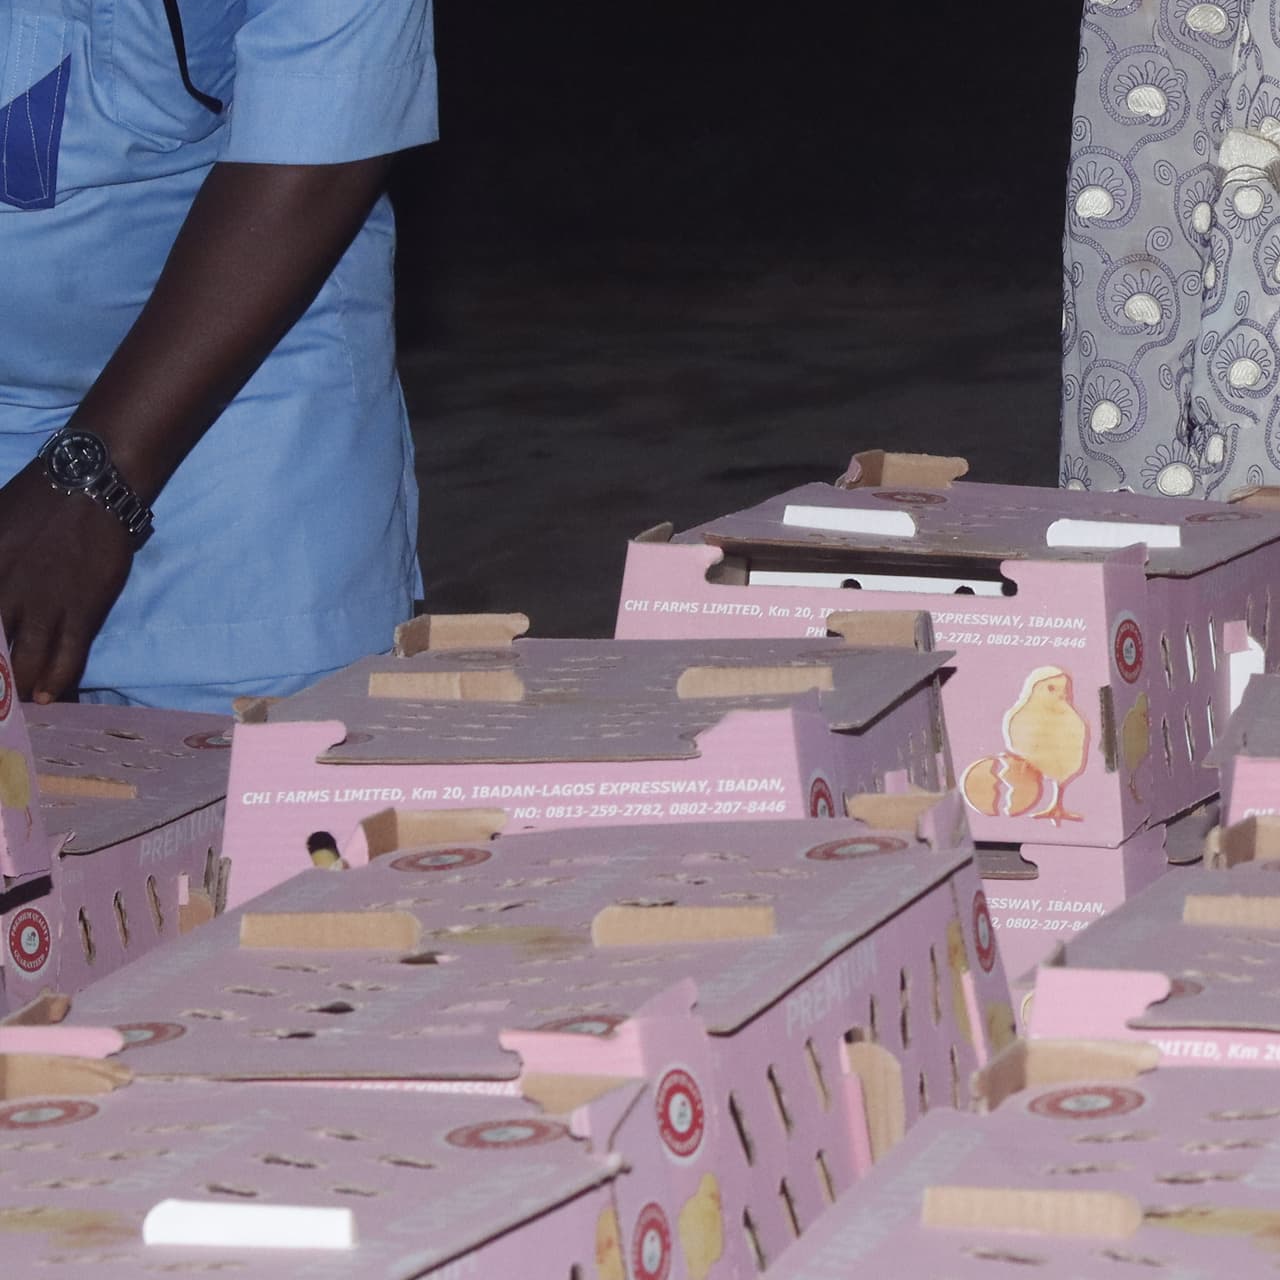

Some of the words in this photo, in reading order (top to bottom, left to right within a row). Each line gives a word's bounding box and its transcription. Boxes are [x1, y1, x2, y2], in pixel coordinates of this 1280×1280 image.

[624, 599, 650, 612] CHI
[653, 600, 699, 614] FARMS
[702, 603, 764, 618] LIMITED,
[768, 605, 791, 617] Km
[794, 607, 815, 620] 20,
[1028, 616, 1087, 631] IBADAN,
[986, 634, 1087, 649] 0802-207-8446
[242, 791, 271, 805] CHI
[276, 789, 329, 803] FARMS
[334, 788, 406, 803] LIMITED,
[412, 786, 437, 800] Km
[443, 785, 466, 801] 20,
[471, 782, 595, 799] IBADAN-LAGOS
[599, 779, 712, 797] EXPRESSWAY,
[717, 777, 785, 794] IBADAN,
[513, 806, 541, 819] NO:
[545, 803, 664, 819] 0813-259-2782,
[669, 800, 786, 817] 0802-207-8446
[1047, 900, 1106, 916] IBADAN,
[1228, 1042, 1259, 1060] Km
